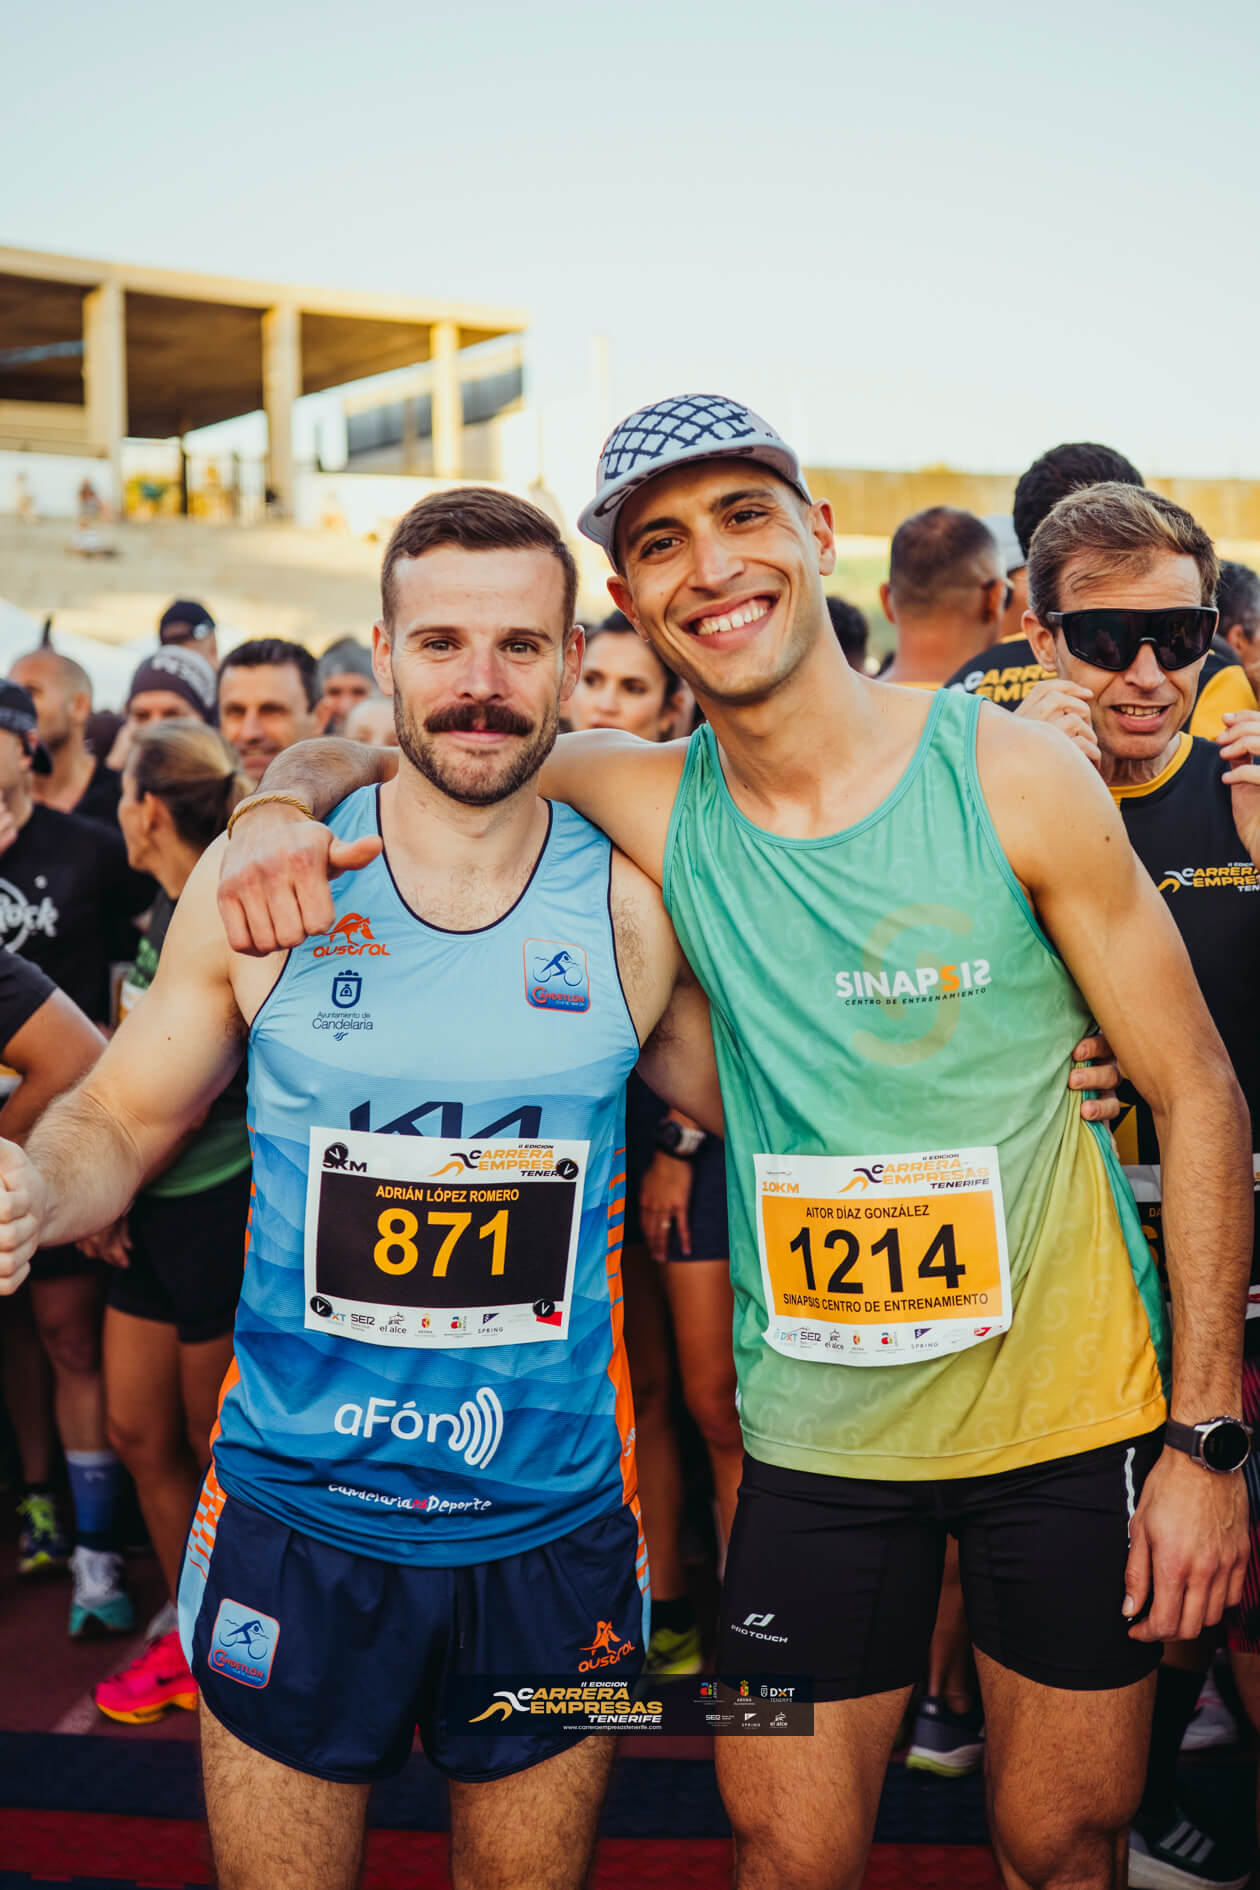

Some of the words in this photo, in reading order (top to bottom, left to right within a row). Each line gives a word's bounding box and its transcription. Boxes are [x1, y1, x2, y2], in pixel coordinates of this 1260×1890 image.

[964, 664, 1058, 691] CARR
[903, 987, 986, 1004] ENTRENAMIENTO
[312, 1018, 373, 1029] Candelaria
[469, 1150, 553, 1159] CARRERA
[478, 1160, 557, 1170] EMPRES
[872, 1160, 962, 1174] CARRERA
[882, 1168, 989, 1185] EMPRESAS
[930, 1178, 989, 1189] TENERIFE
[376, 1185, 423, 1201] ADRIÁN
[427, 1187, 466, 1202] LÓPEZ
[470, 1189, 519, 1202] ROMERO
[762, 1181, 799, 1193] 10KM
[806, 1208, 833, 1219] AITOR
[837, 1206, 861, 1219] DÍAZ
[864, 1205, 930, 1219] GONZÁLEZ
[373, 1208, 509, 1277] 871
[790, 1224, 966, 1294] 1214
[783, 1293, 820, 1308] SINAPSIS
[822, 1299, 861, 1312] CENTRO
[865, 1302, 880, 1312] DE
[884, 1293, 988, 1311] ENTRENAMIENTO
[379, 1324, 387, 1332] el
[389, 1326, 407, 1334] alce
[749, 1631, 788, 1643] TOUCH
